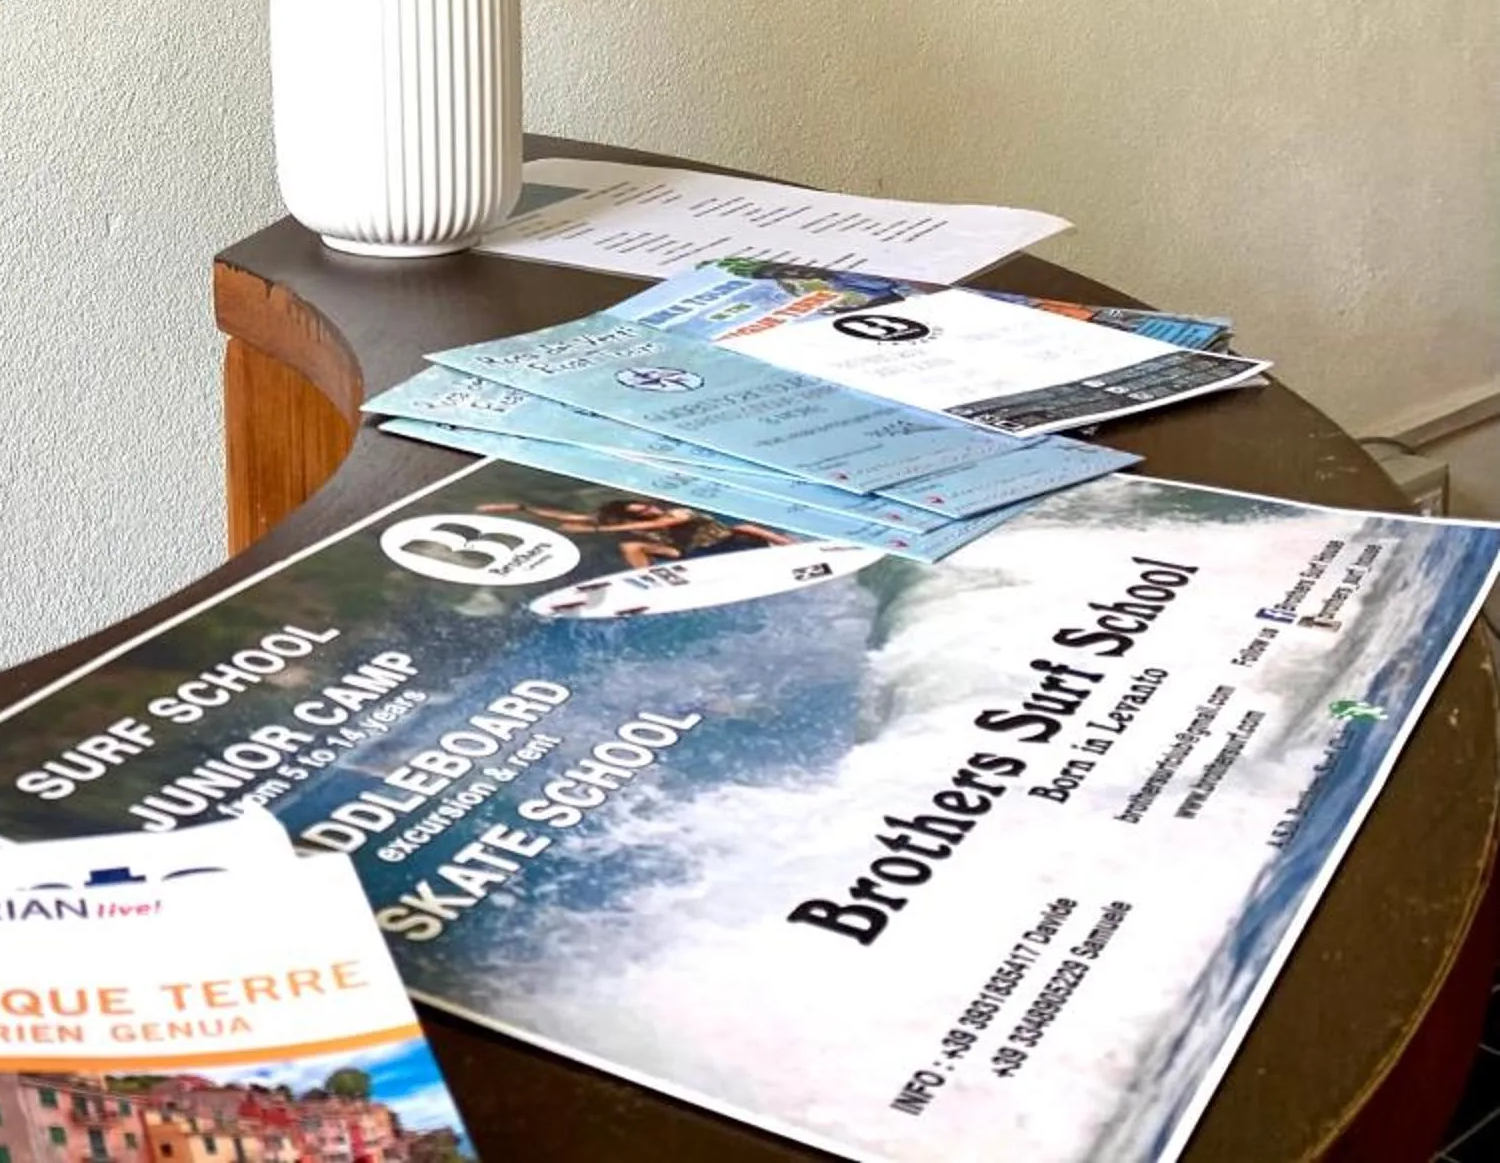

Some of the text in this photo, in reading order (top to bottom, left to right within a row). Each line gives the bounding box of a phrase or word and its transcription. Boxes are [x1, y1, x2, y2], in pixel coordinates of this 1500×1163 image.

[15, 624, 341, 801] SURF SCHOOL
[129, 649, 420, 833] JUNIOR CAMP
[277, 764, 309, 780] 5
[296, 748, 337, 768] to
[326, 727, 367, 748] 14
[358, 689, 427, 737] years
[297, 678, 571, 856] DDLEBOARD
[377, 733, 564, 863] excursion & rent
[787, 751, 1028, 947] Brothers
[974, 658, 1105, 744] Surf
[1052, 556, 1200, 657] School
[1028, 667, 1169, 804] Born in Levanto
[97, 900, 162, 918] live!
[375, 710, 703, 942] SKATE SCHOOL
[110, 1015, 253, 1043] GENUA
[160, 959, 370, 1012] TERRE
[889, 1069, 946, 1116] INFO
[941, 1028, 978, 1060] +39
[1022, 896, 1078, 946] Davide
[990, 1045, 1029, 1079] +39
[1069, 899, 1134, 961] Samuele
